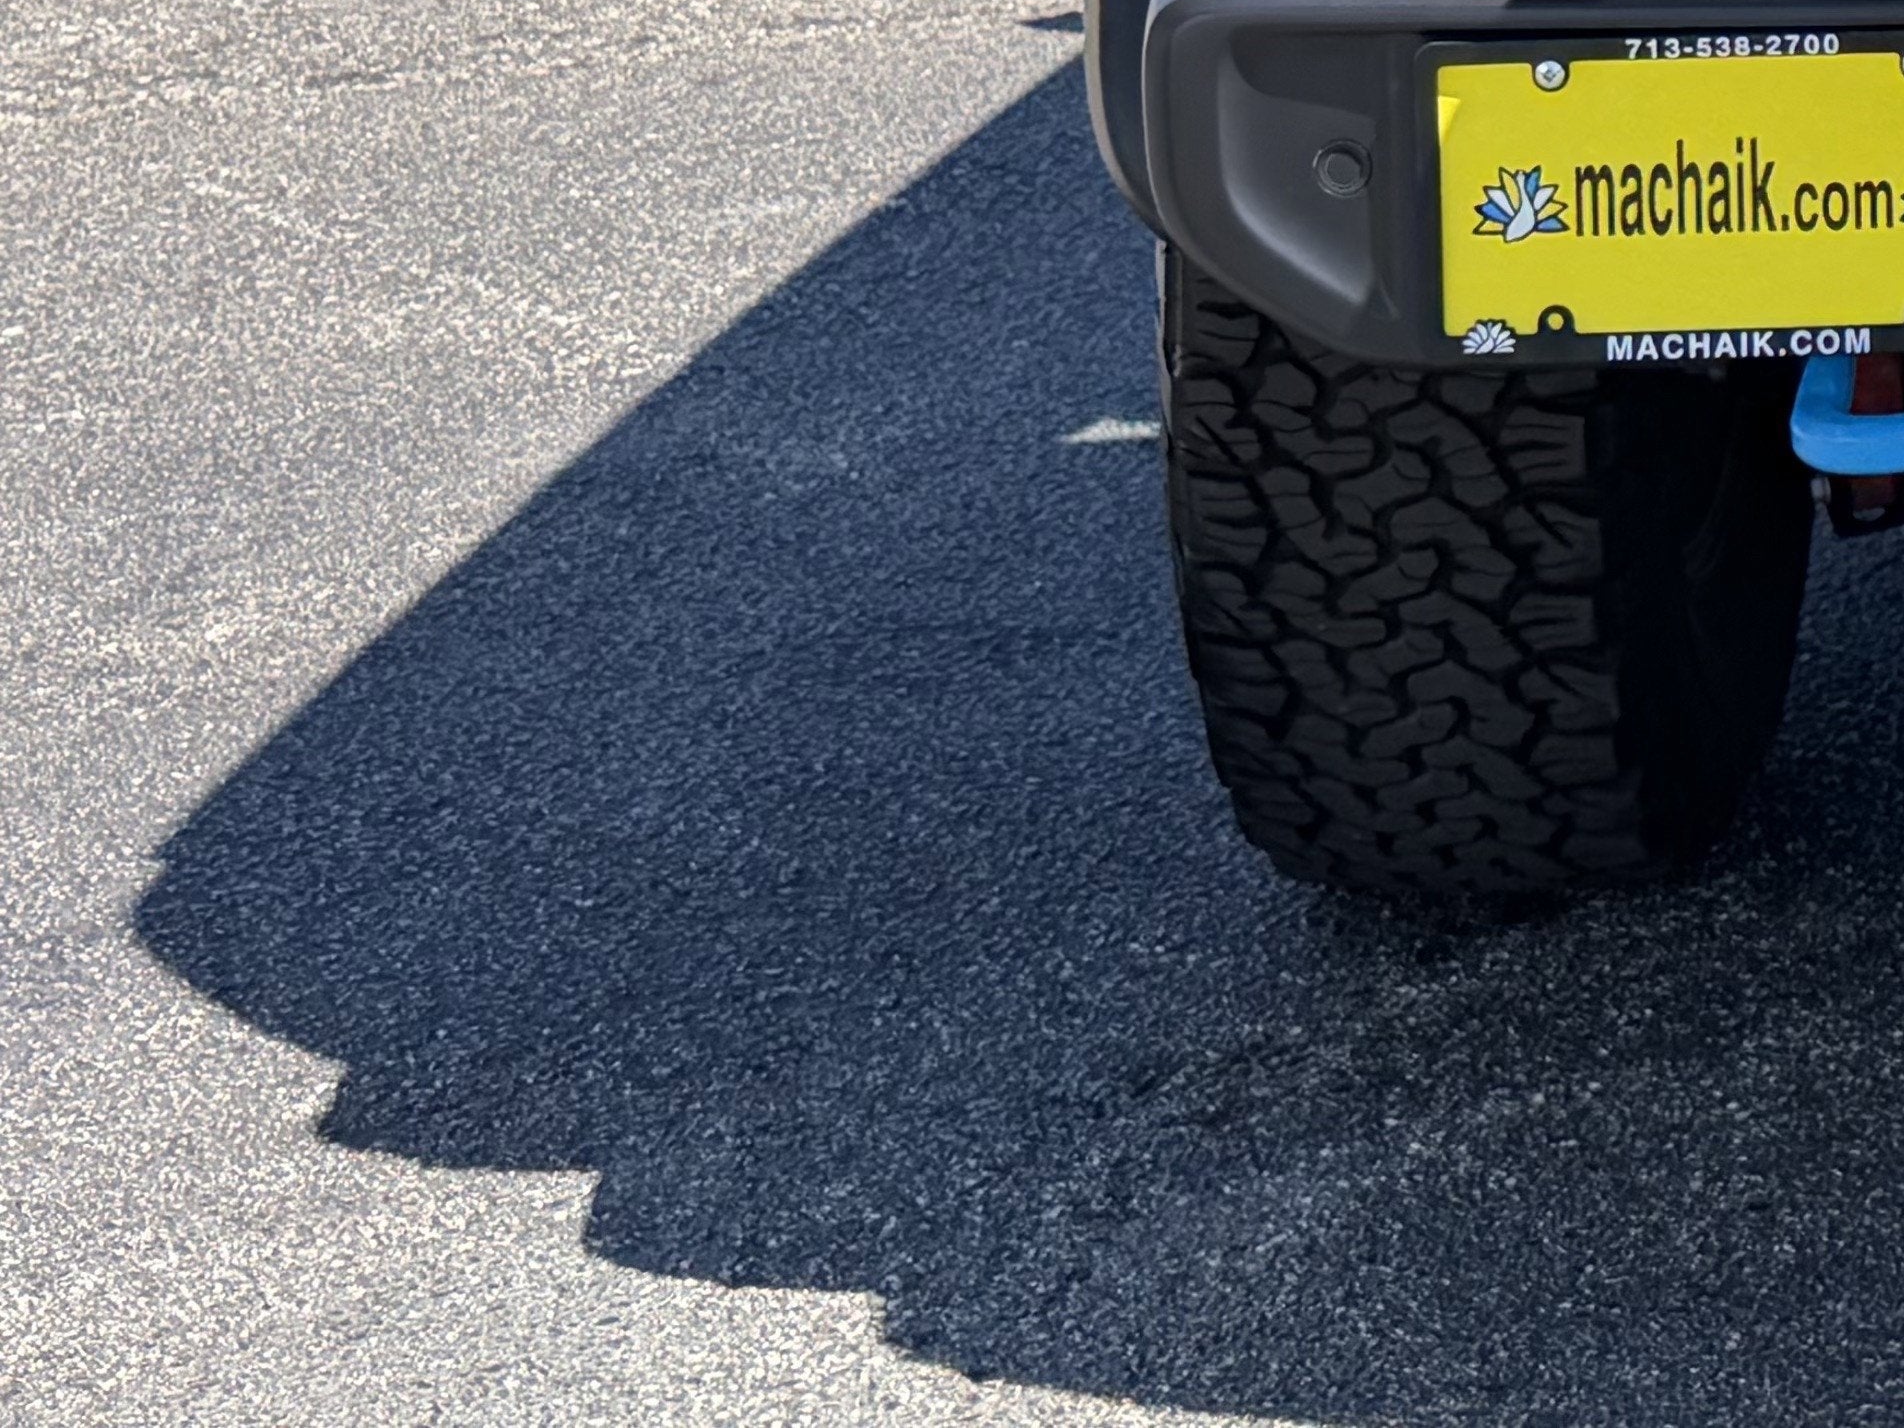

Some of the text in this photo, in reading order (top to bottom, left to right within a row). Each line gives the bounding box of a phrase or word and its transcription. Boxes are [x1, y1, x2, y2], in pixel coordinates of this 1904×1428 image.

[1624, 33, 1840, 60] 713-538-2700
[1574, 136, 1894, 237] machaik.com
[1606, 327, 1872, 361] MACHAIK.COM
